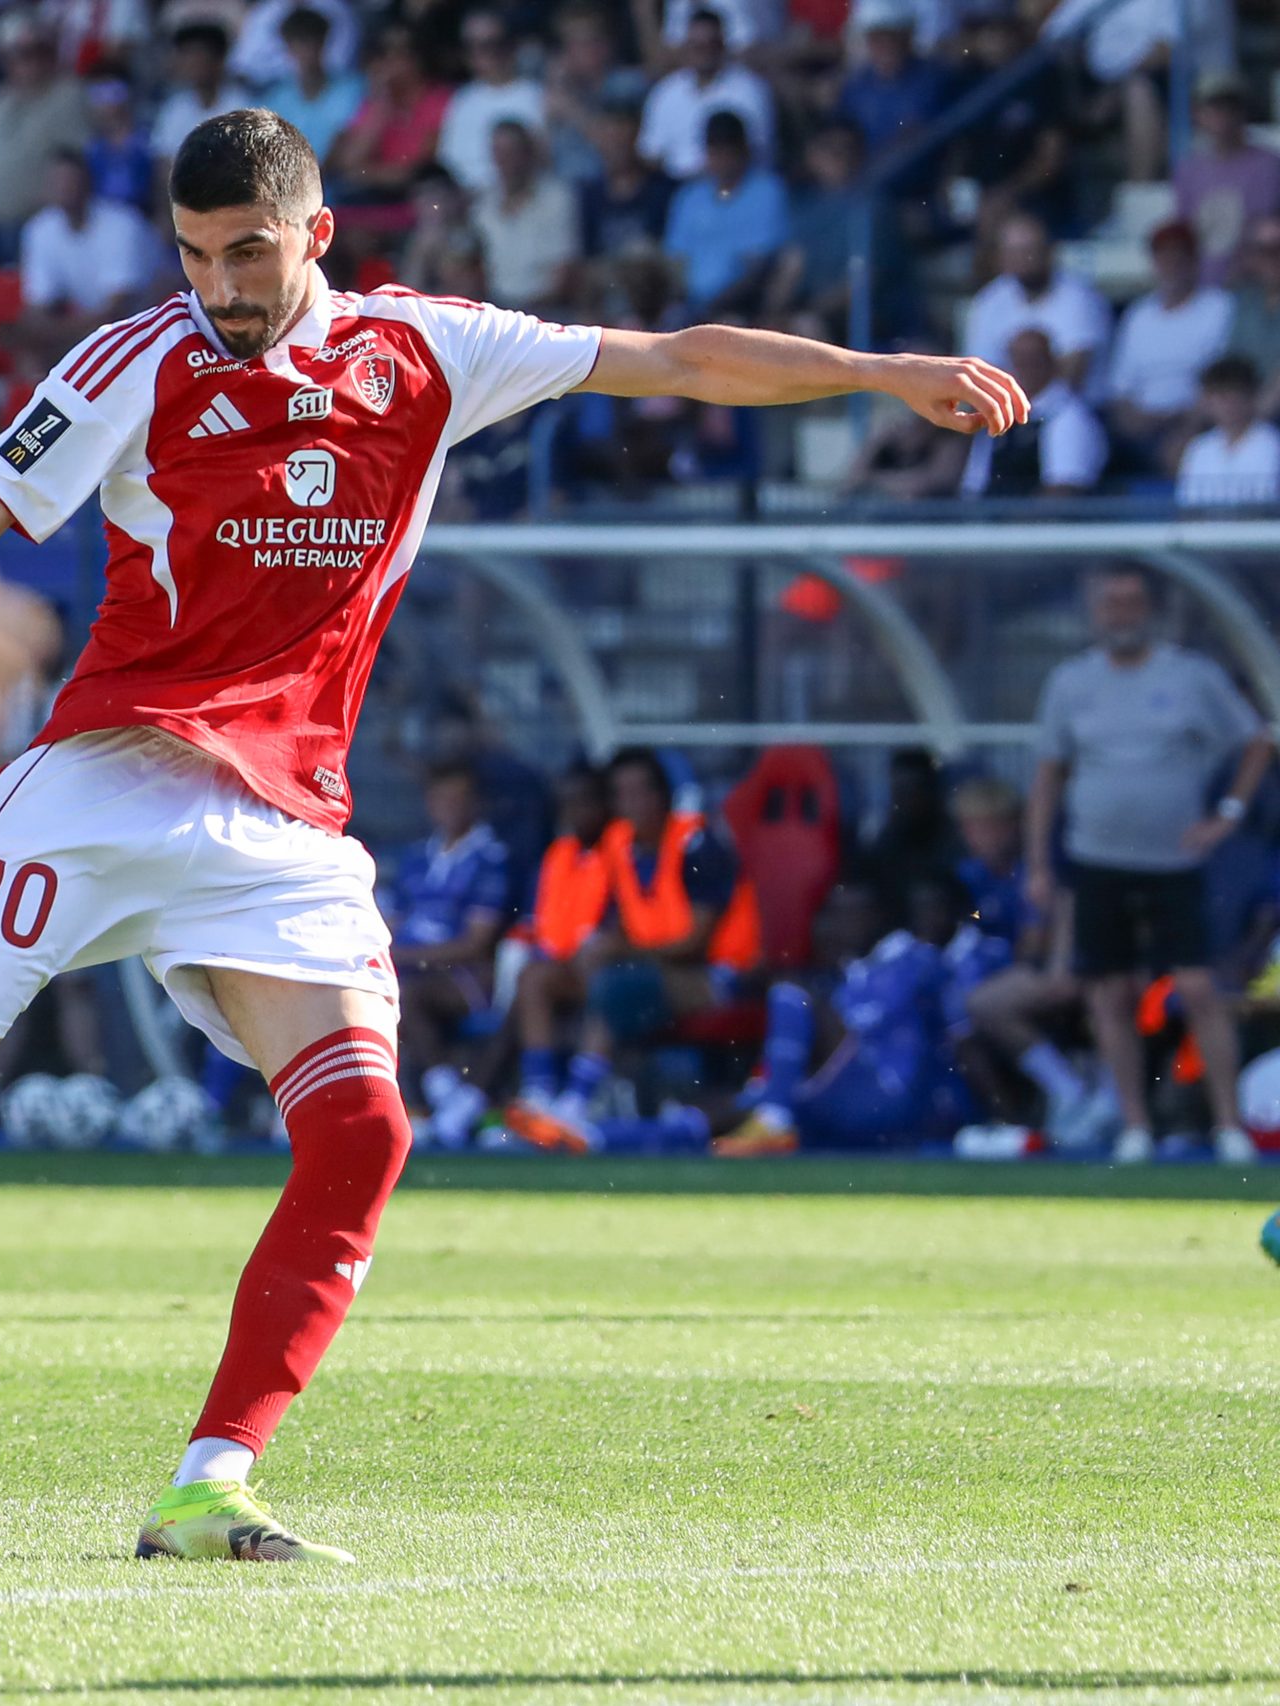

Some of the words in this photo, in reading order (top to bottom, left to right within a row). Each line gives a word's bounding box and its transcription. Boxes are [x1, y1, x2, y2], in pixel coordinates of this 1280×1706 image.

[187, 349, 218, 367] GU
[193, 361, 243, 378] environne
[292, 393, 328, 417] Sill
[215, 517, 386, 548] QUEGUINER
[254, 548, 364, 569] MATERIAUX
